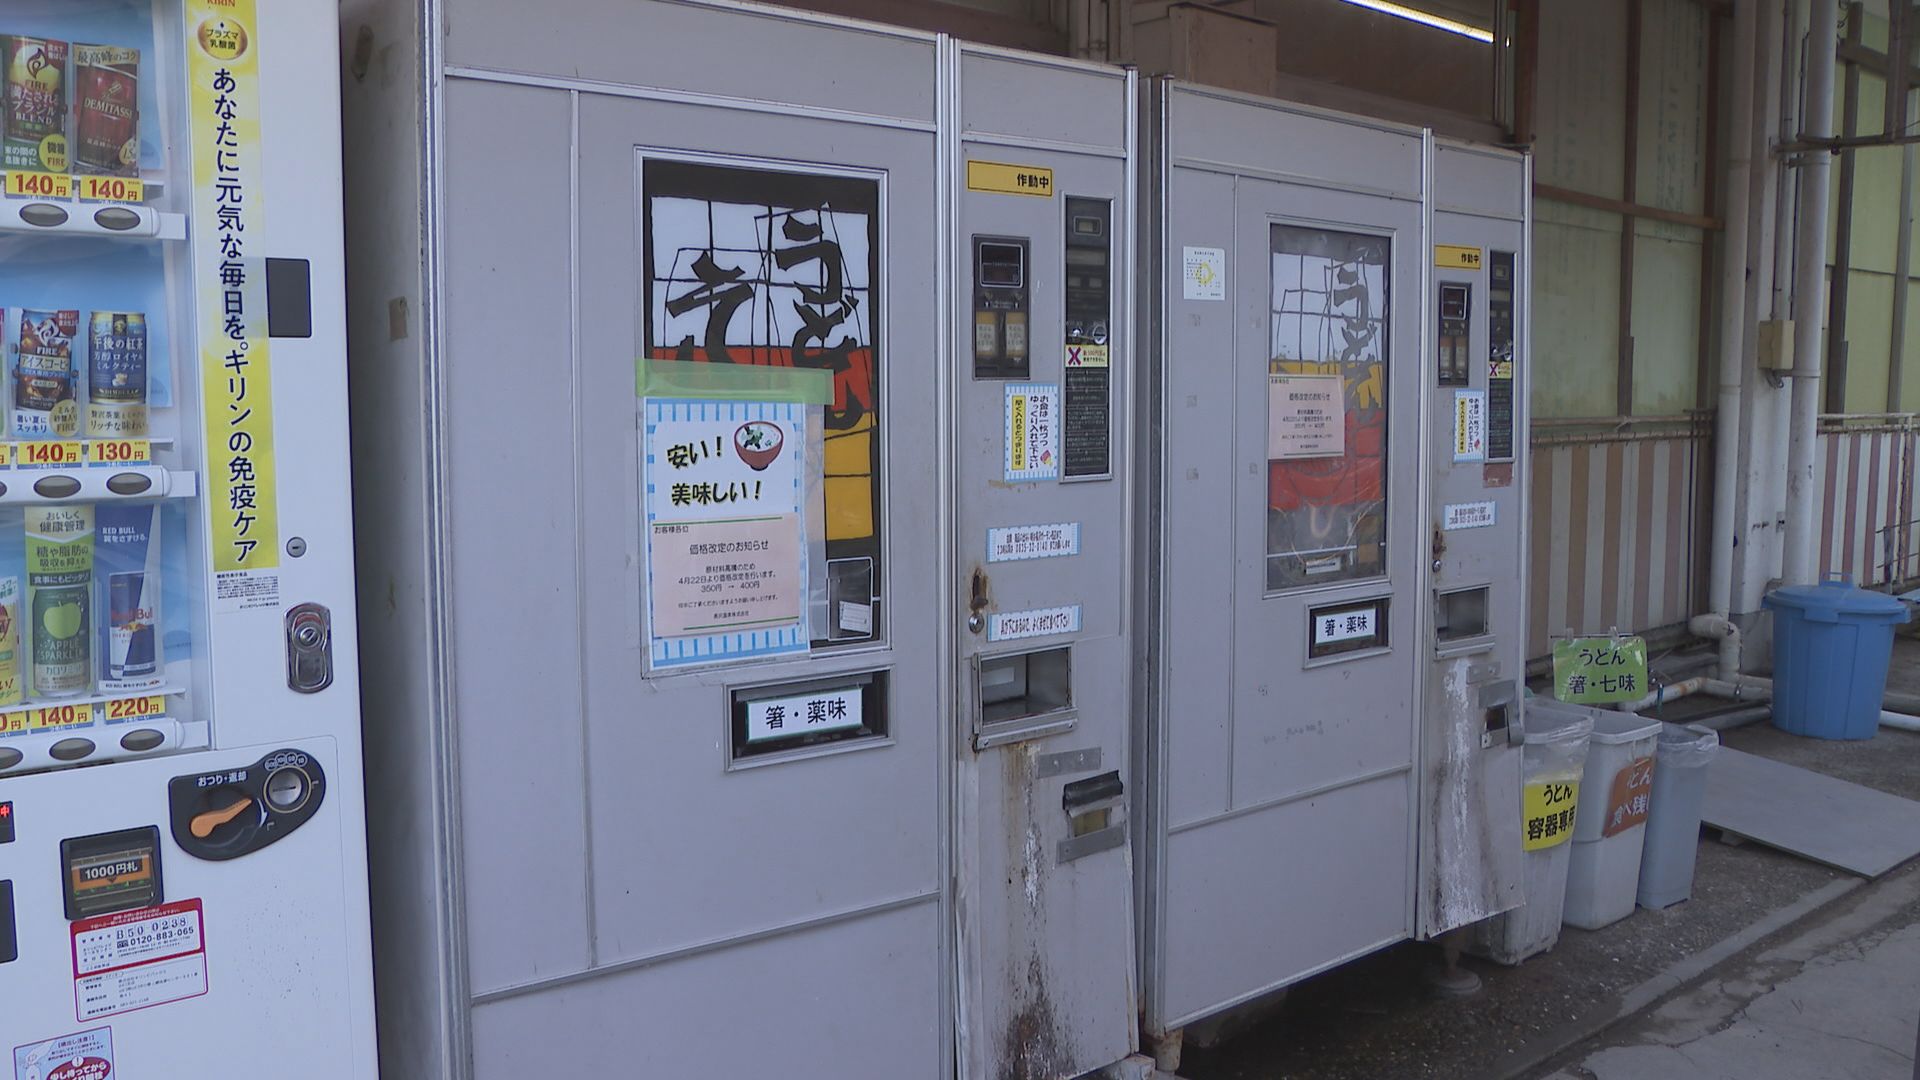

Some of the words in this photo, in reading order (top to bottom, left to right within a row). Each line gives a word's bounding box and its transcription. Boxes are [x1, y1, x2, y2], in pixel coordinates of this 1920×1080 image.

[206, 28, 239, 40] プラズマ
[48, 157, 65, 167] FIRE
[16, 174, 67, 196] 140円
[89, 178, 138, 201] 140円
[1017, 173, 1049, 189] 作動中
[36, 346, 58, 356] FIRE
[93, 335, 144, 350] 午後の紅茶
[17, 424, 47, 433] スッキリ
[27, 444, 77, 463] 140円
[96, 442, 144, 461] 130円
[667, 436, 722, 469] 安い！
[672, 480, 761, 506] 美味しい！
[46, 510, 80, 520] おいしく
[39, 520, 85, 533] 健康管理
[654, 525, 689, 534] お客様各位
[689, 540, 769, 555] 価格改定のお知らせ
[701, 584, 722, 593] 350円
[740, 580, 760, 589] 400円
[1325, 614, 1368, 637] 箸・薬味
[1579, 648, 1626, 667] うどん
[1569, 675, 1636, 694] 箸・七味
[38, 705, 88, 726] 140円
[110, 697, 159, 718] 220円
[765, 696, 847, 730] 箸・薬味
[198, 770, 247, 787] おつり・返却
[85, 861, 138, 880] 1000円札
[151, 917, 187, 933] 0238
[130, 926, 194, 946] 0120-883-065
